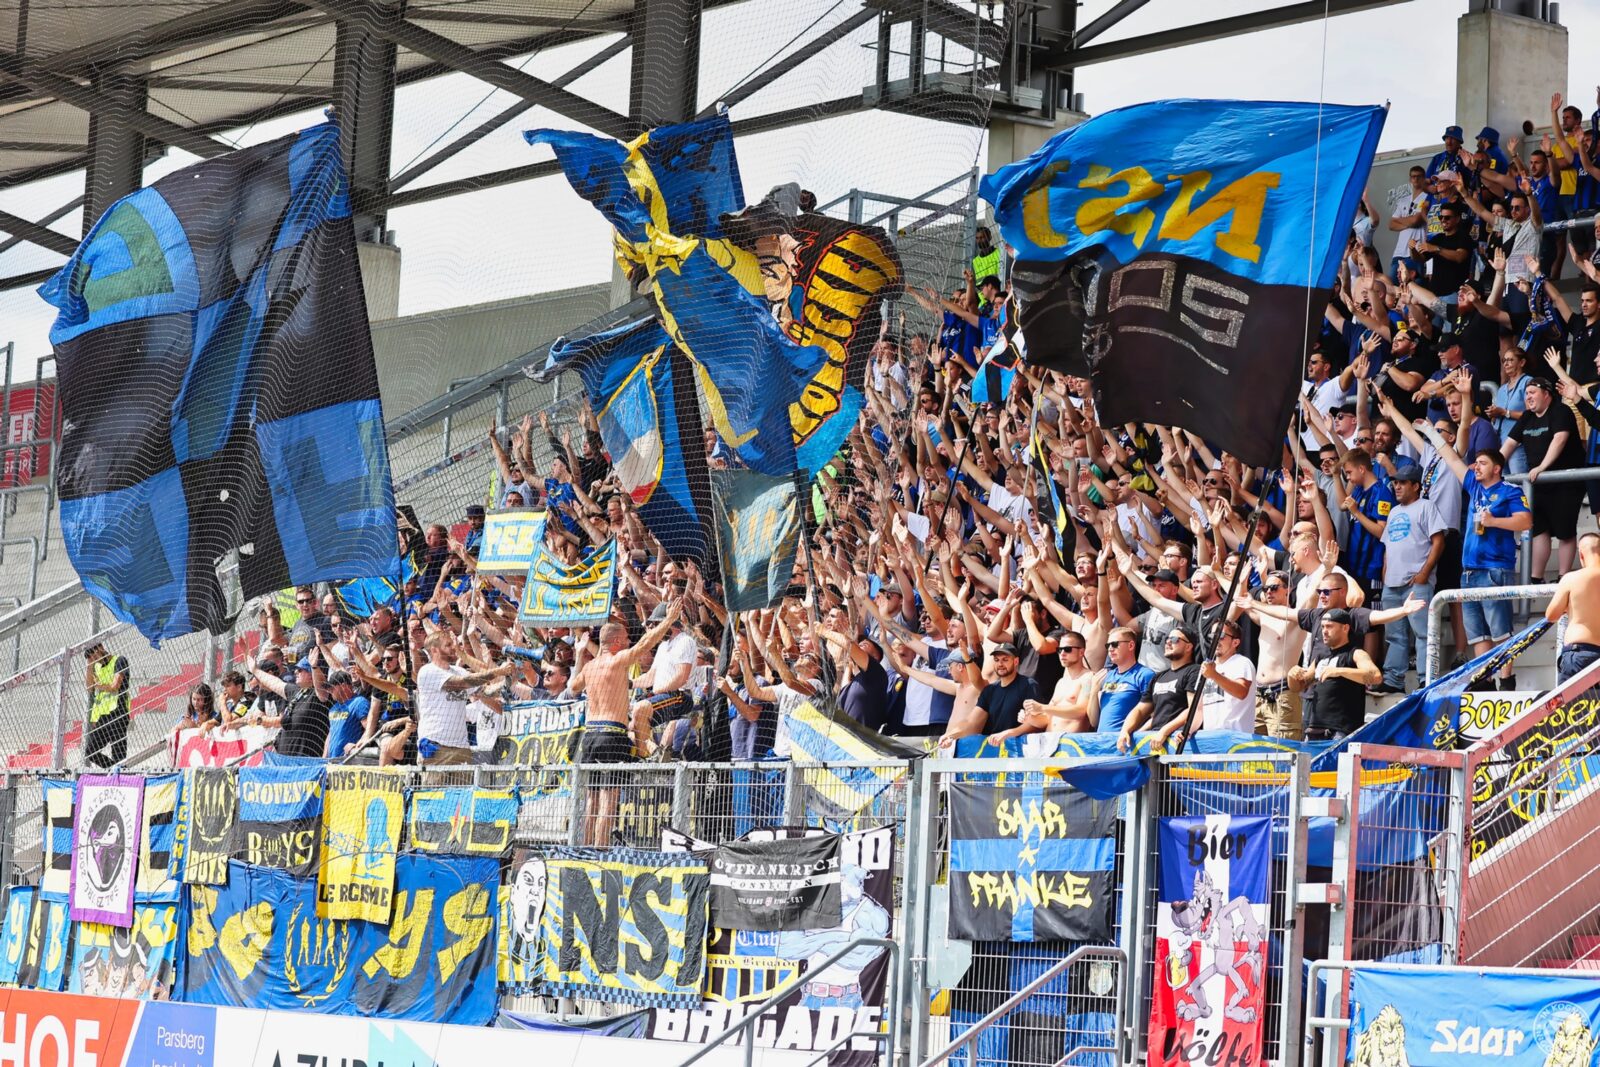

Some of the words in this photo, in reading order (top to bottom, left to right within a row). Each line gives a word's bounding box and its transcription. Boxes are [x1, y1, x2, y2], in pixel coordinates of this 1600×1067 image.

[996, 798, 1067, 844] SAAR
[1187, 824, 1248, 867] Bier
[319, 883, 335, 904] LE
[157, 1026, 205, 1055] Parsberg
[652, 1004, 881, 1051] BRIGADE
[1430, 1019, 1525, 1056] Saar
